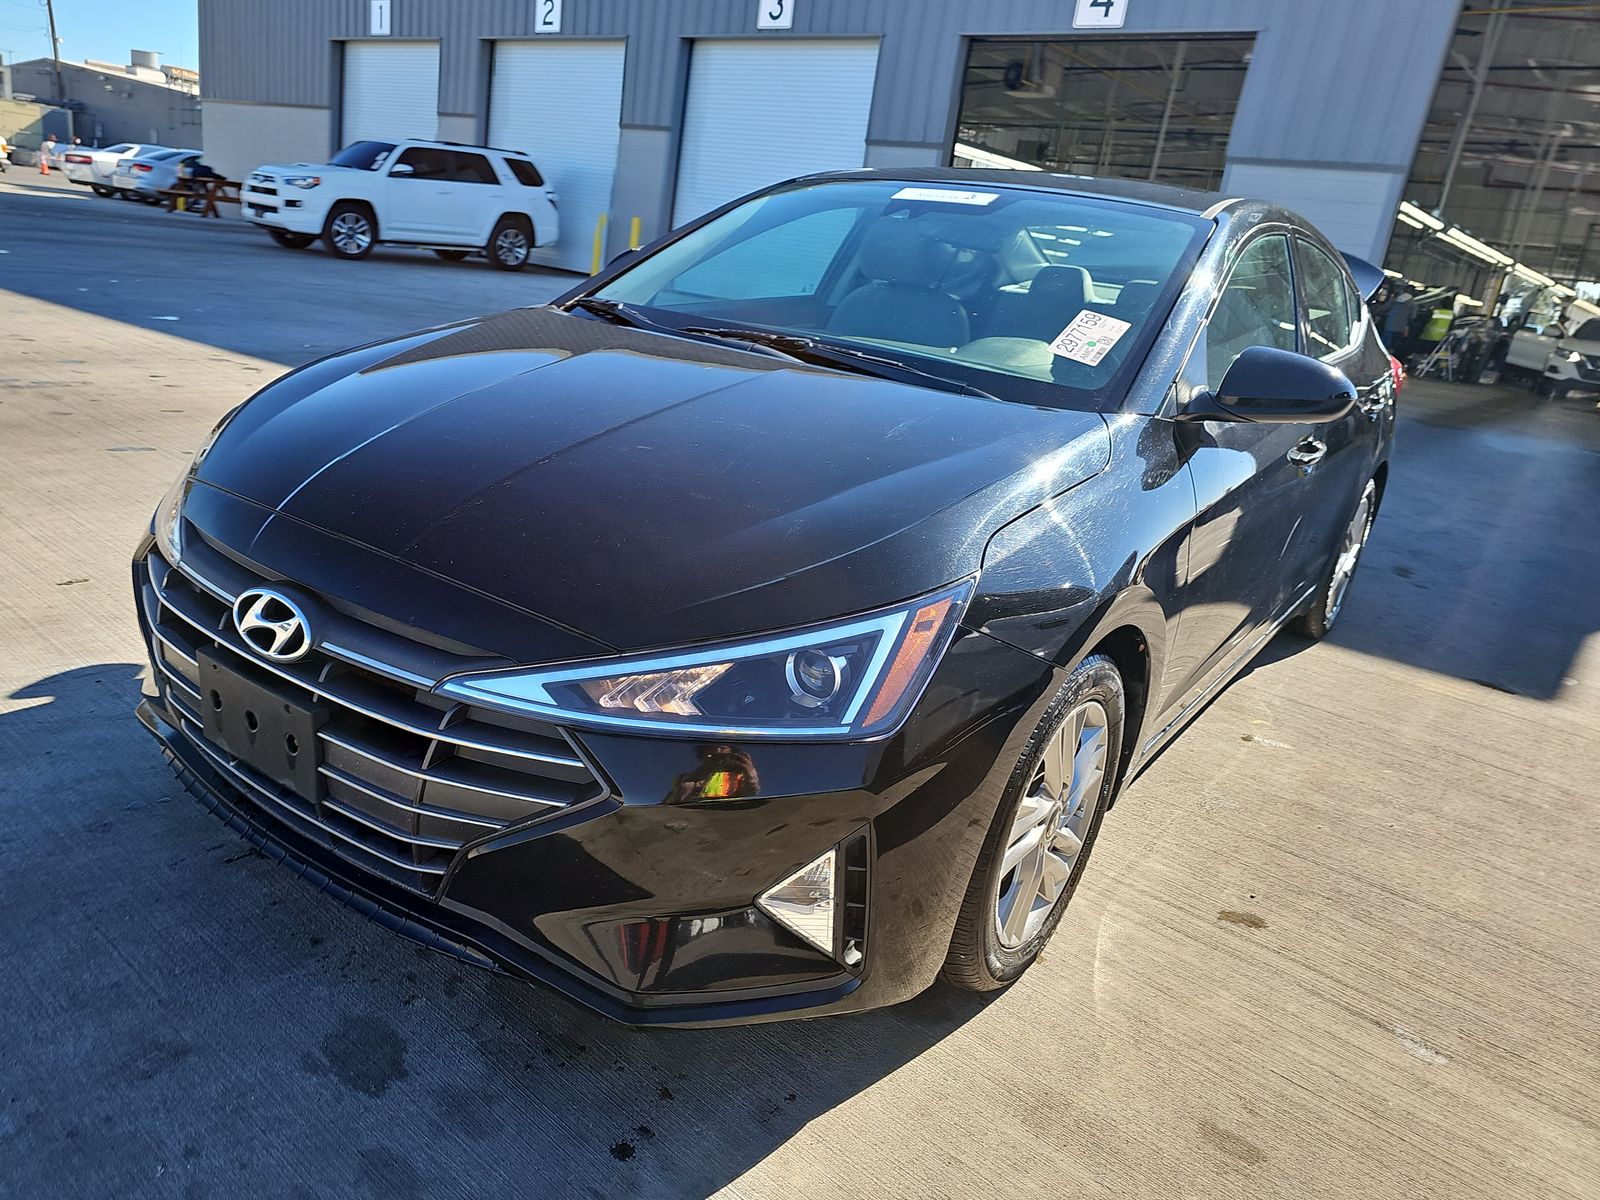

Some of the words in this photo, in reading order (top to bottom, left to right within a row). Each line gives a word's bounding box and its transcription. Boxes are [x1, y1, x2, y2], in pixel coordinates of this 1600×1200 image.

[543, 0, 554, 25] 2
[769, 0, 783, 20] 3
[1056, 313, 1102, 353] 2977159
